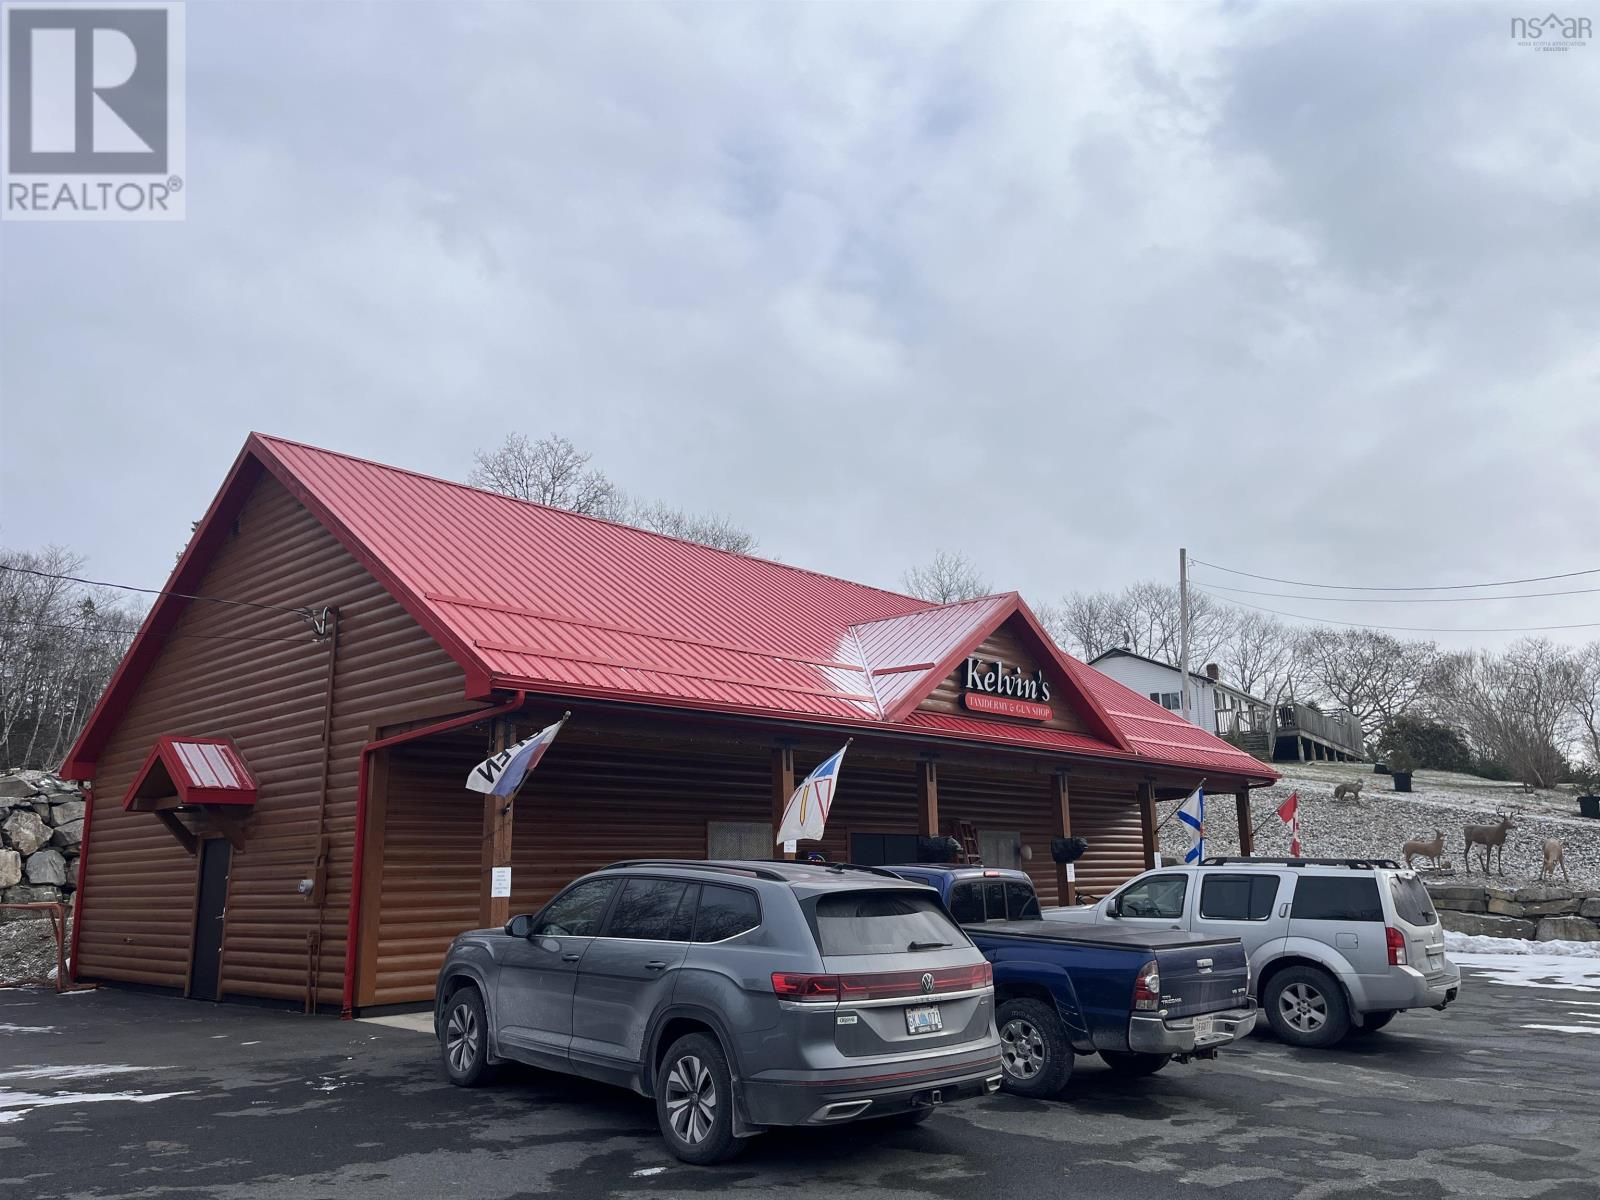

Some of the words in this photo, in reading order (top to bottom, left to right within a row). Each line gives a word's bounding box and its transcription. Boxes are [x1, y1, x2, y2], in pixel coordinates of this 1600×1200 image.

[966, 657, 1050, 701] Kelvin's
[969, 696, 1008, 711] TAXIDERMY
[1016, 704, 1031, 714] GUN
[1032, 708, 1050, 718] SHOP
